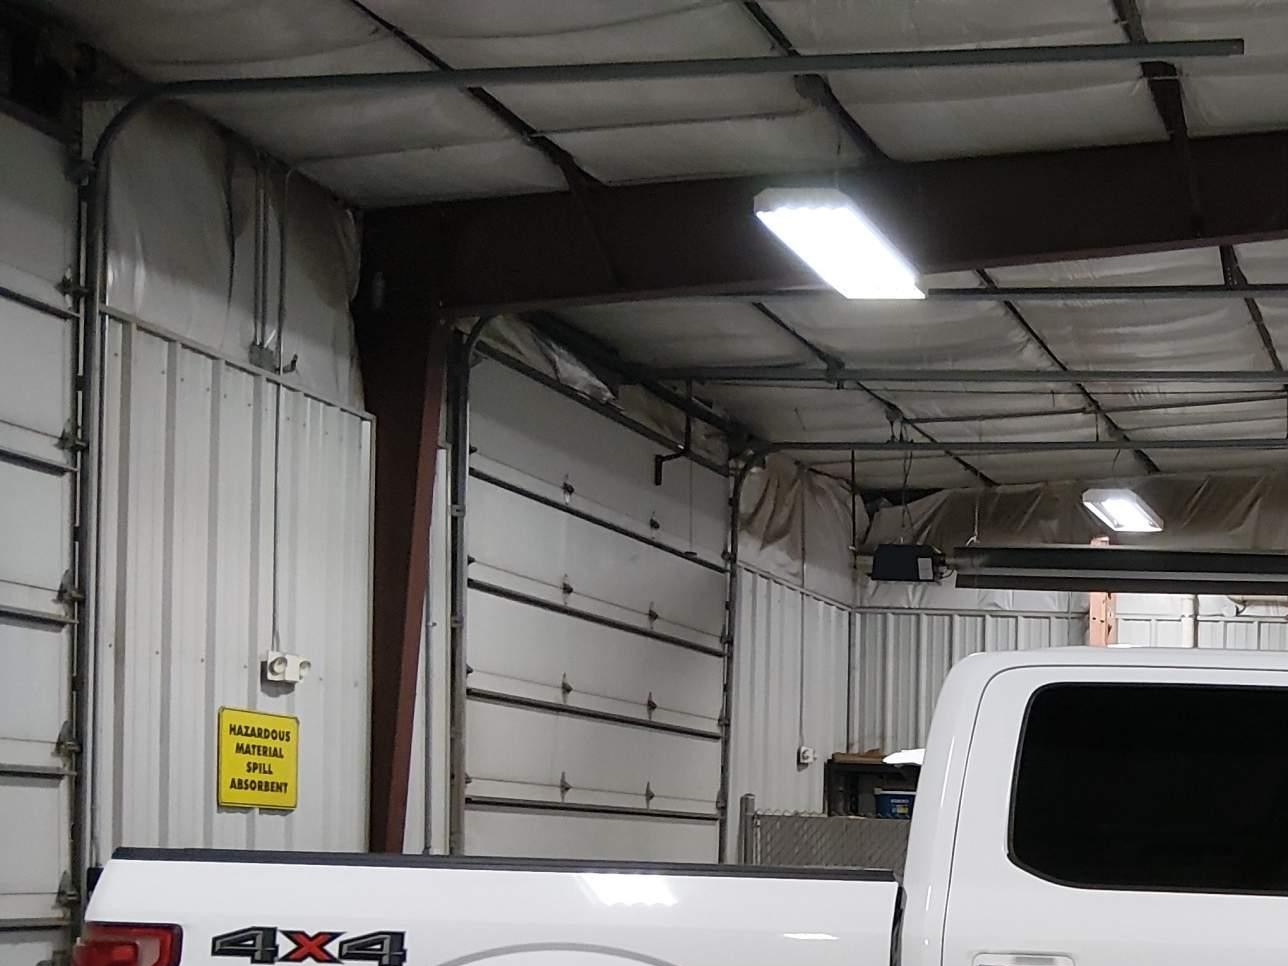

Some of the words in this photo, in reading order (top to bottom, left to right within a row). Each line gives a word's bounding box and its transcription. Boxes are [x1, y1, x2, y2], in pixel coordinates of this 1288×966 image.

[229, 723, 291, 742] HAZARDOUS
[235, 742, 284, 759] MATERIAL
[246, 761, 273, 775] SPILL
[229, 777, 288, 794] ABSORBENT
